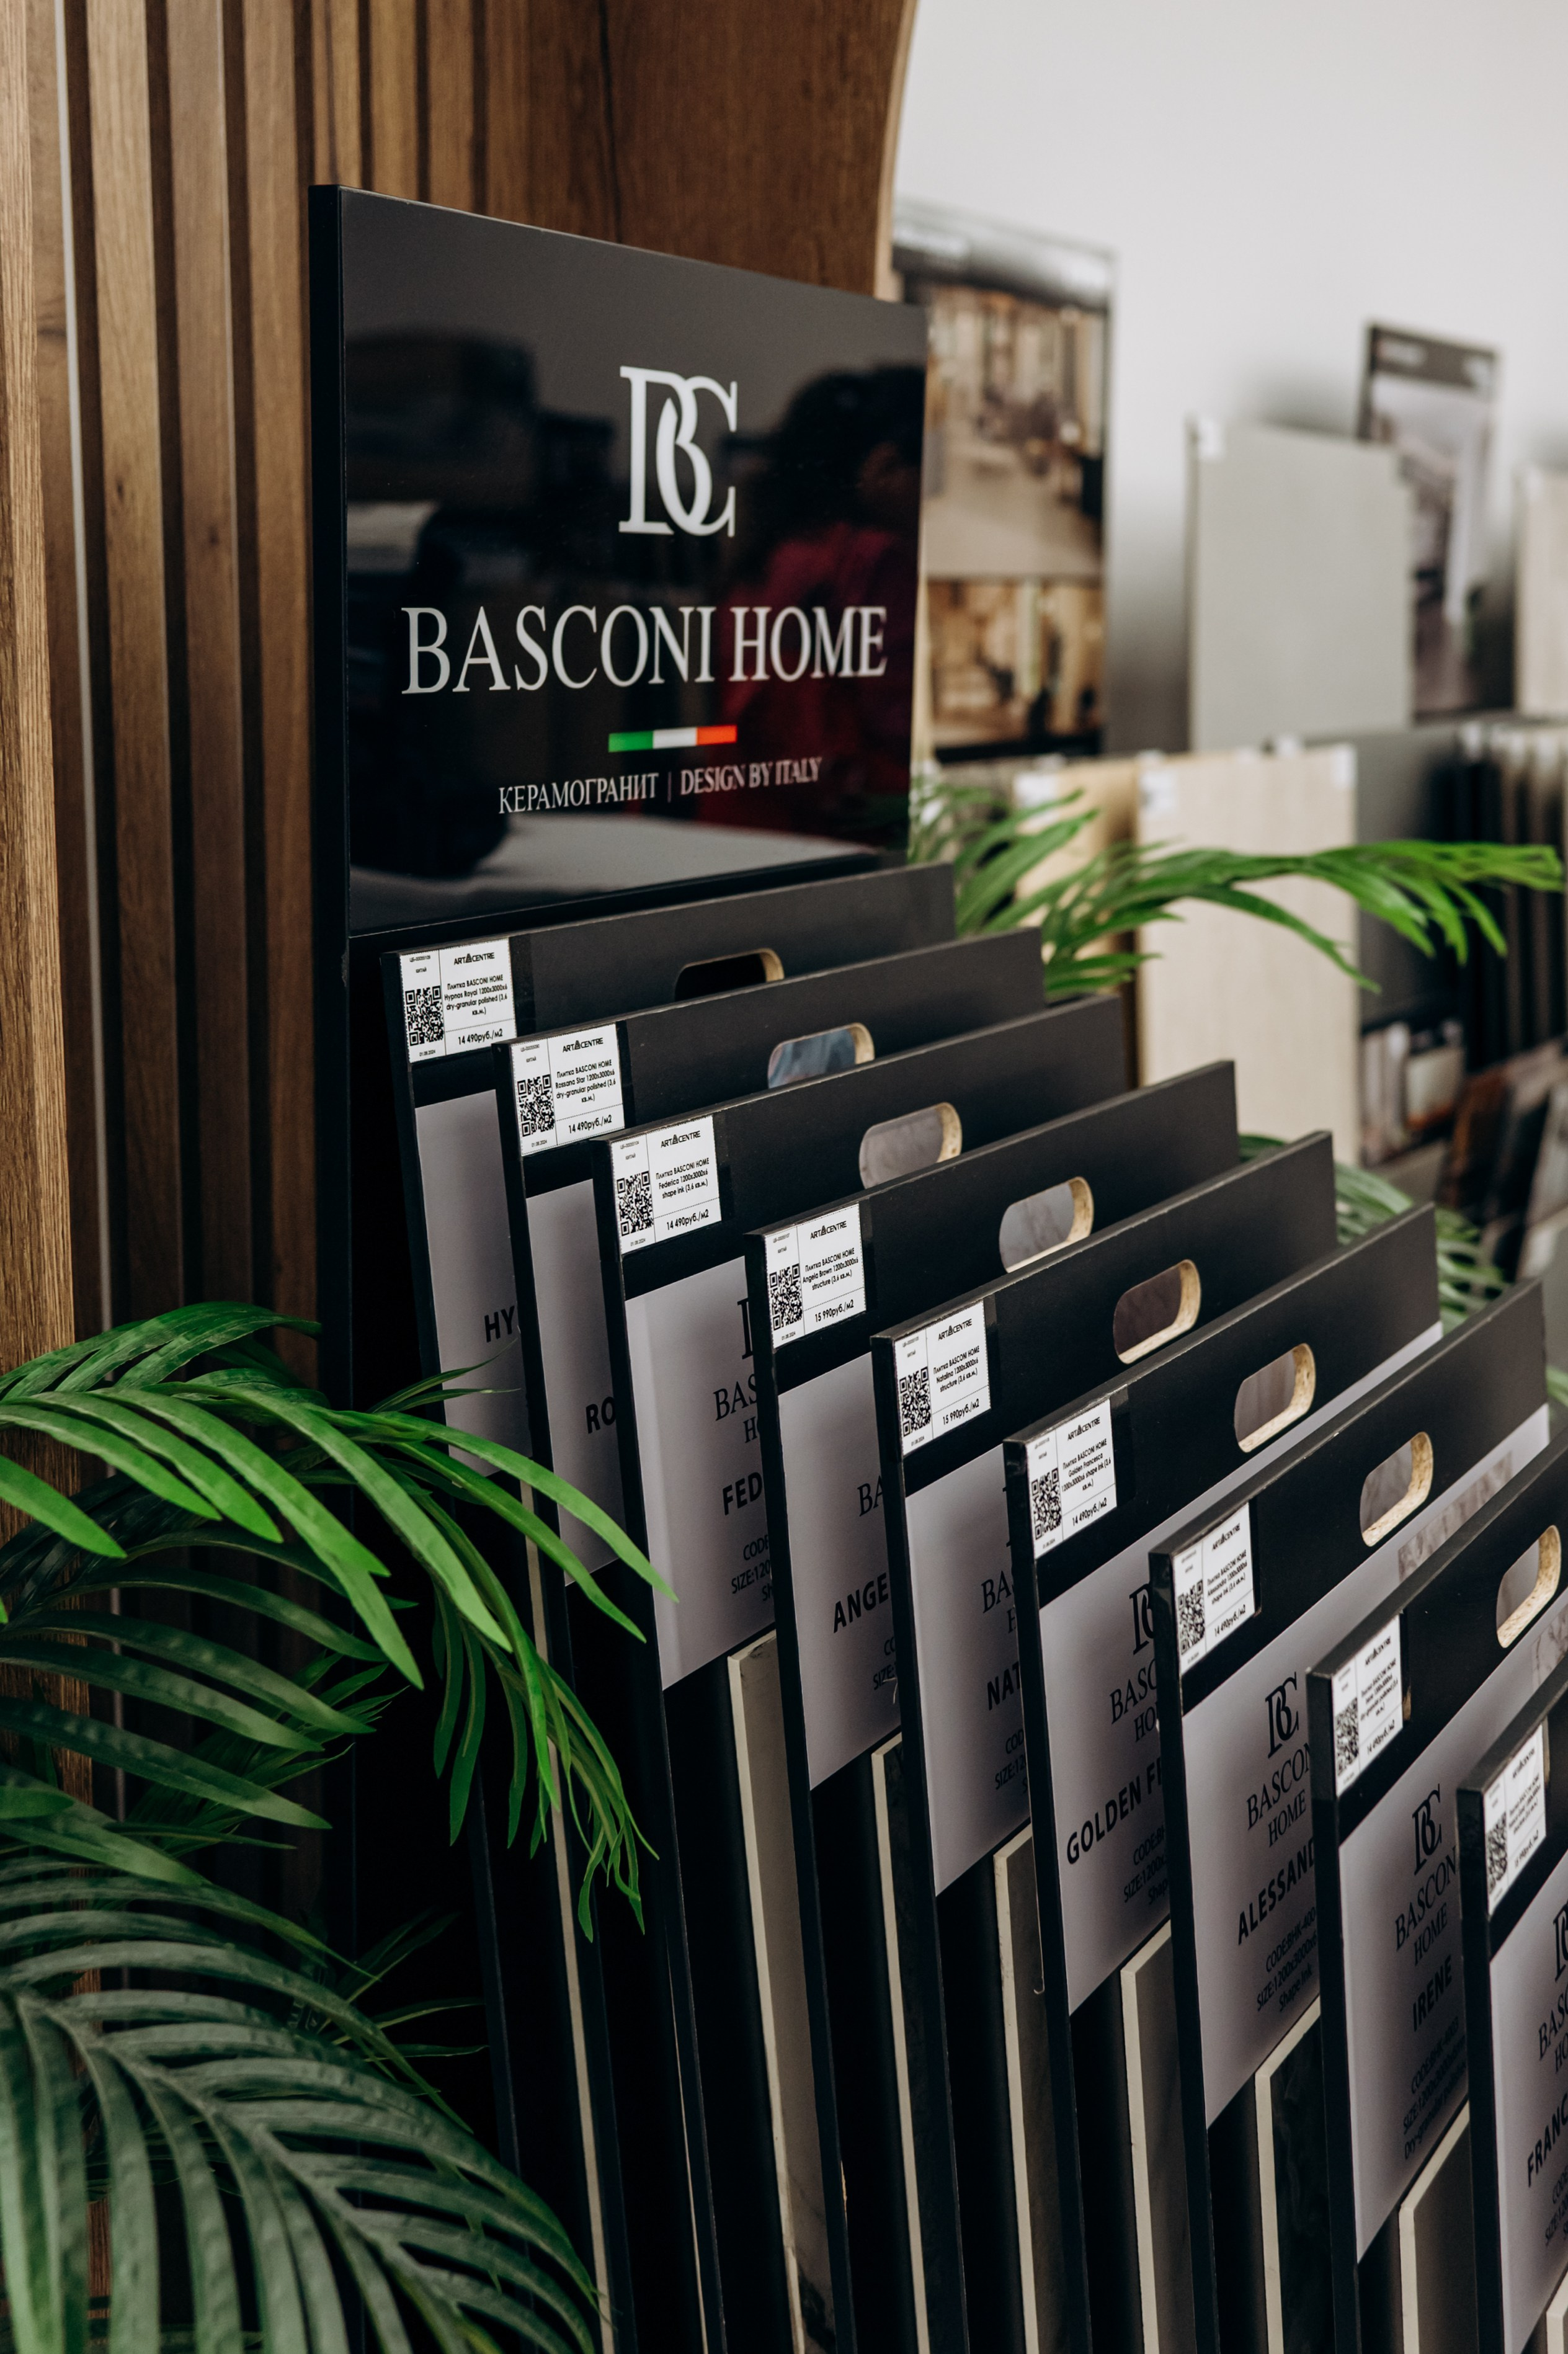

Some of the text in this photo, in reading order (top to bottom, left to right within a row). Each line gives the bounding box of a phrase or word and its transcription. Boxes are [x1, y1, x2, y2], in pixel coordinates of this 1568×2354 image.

[401, 604, 888, 695] BASCONI HOME
[498, 757, 822, 814] КЕРАМОГРАНИТ DESIGN BY ITALY
[466, 978, 488, 987] BASCONI
[489, 974, 503, 983] HOME
[444, 992, 463, 1001] Hypnos
[464, 989, 478, 997] Royal
[446, 999, 477, 1010] dry-granular
[478, 995, 498, 1006] polished
[472, 1007, 486, 1015] кв.м.)
[458, 1028, 503, 1045] 14 490руб./м2
[556, 1059, 612, 1078] Плитка BASCONI HOME
[555, 1079, 576, 1089] Rossana
[556, 1087, 586, 1099] dry-granular
[587, 1081, 607, 1093] polished
[581, 1094, 595, 1103] кв.м.)
[569, 1114, 612, 1133] 14 490руб./м2
[656, 1157, 710, 1179] Плитка BASCONI HOME
[659, 1179, 679, 1189] Federica
[662, 1190, 677, 1199] shape
[667, 1209, 709, 1230] 14 490руб./м2
[805, 1247, 855, 1272] Плитка BASCONI HOME
[819, 1268, 832, 1277] Brown
[812, 1279, 831, 1290] structure
[815, 1299, 854, 1322] 15 990руб./м2
[933, 1345, 979, 1373] Плитка BASCONI HOME
[940, 1380, 957, 1393] structure
[586, 1396, 617, 1434] RO
[943, 1398, 979, 1425] 15 990руб./м2
[1077, 1446, 1095, 1461] BASCONI
[1095, 1438, 1107, 1450] HOME
[723, 1472, 762, 1515] FED
[1072, 1515, 1078, 1525] 14
[834, 1572, 889, 1633] ANGE
[1067, 1775, 1141, 1864] GOLDEN
[1268, 1789, 1306, 1847] HOME
[1414, 1902, 1448, 1966] HOME
[1413, 1955, 1452, 2031] IRENE
